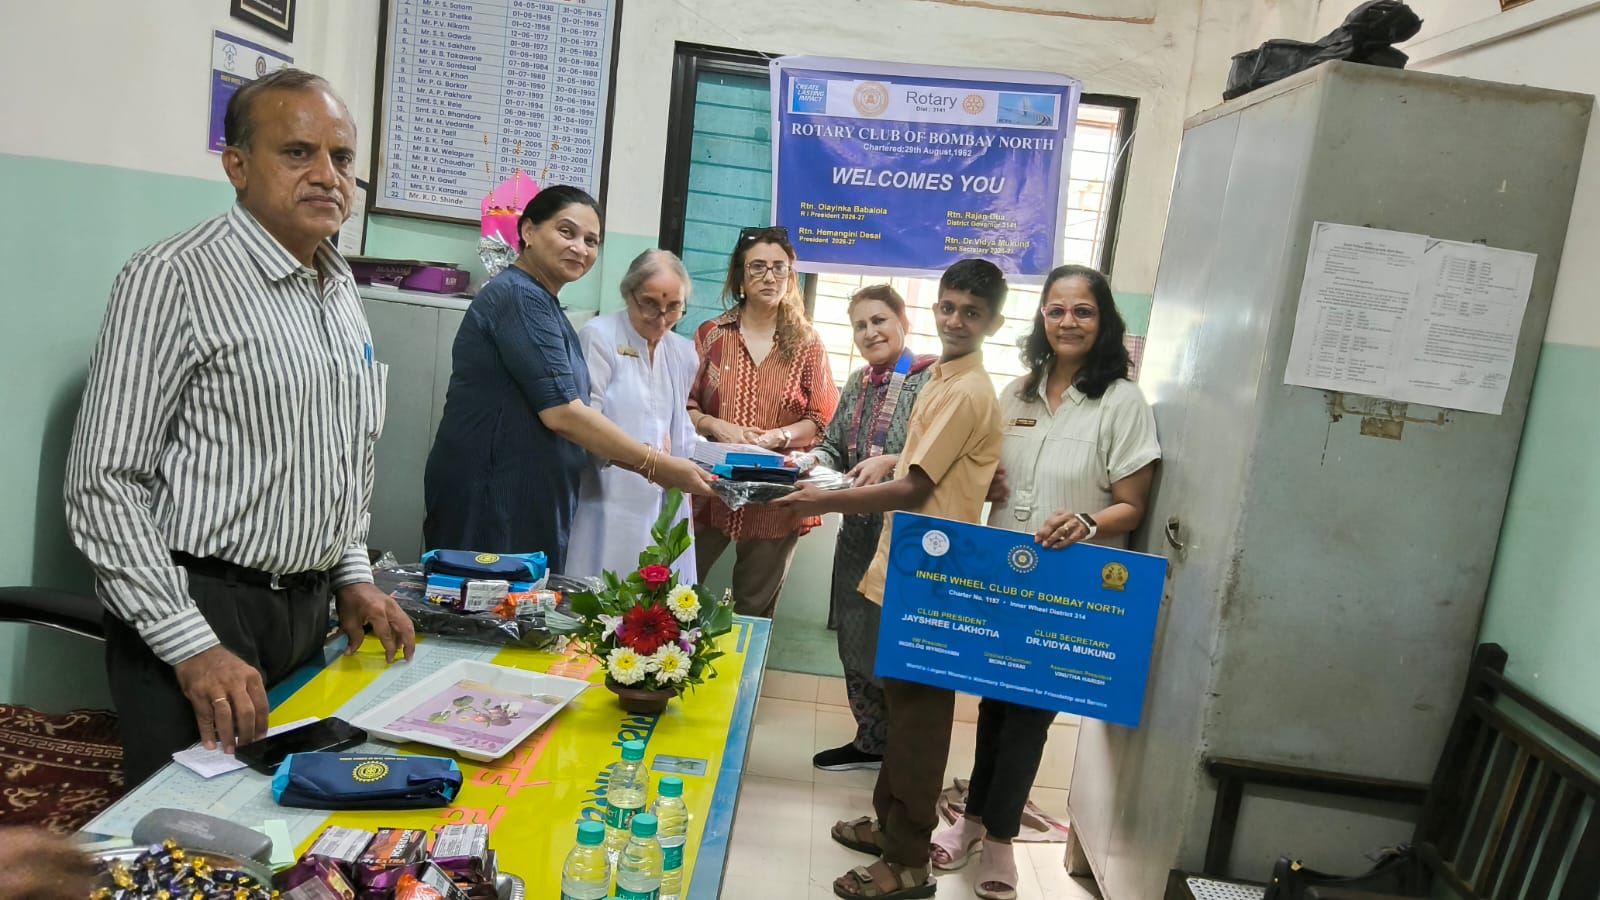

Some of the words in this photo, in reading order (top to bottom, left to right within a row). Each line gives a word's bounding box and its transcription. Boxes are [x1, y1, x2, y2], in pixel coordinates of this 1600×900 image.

[451, 72, 468, 80] Khan
[906, 91, 958, 109] Rotary
[442, 129, 457, 137] Patil
[791, 123, 855, 139] ROTARY
[858, 127, 900, 142] CLUB
[904, 130, 926, 143] OF
[929, 134, 996, 148] BOMBAY
[1000, 136, 1054, 150] NORTH
[832, 167, 954, 192] WELCOMES
[961, 176, 1005, 194] YOU
[440, 196, 464, 205] Shinde
[801, 202, 816, 210] Rtn.
[854, 205, 888, 215] Babalola
[947, 211, 962, 219] Rtn.
[799, 227, 814, 235] Rtn.
[817, 228, 858, 238] Hemangini
[860, 232, 881, 240] Desai
[800, 236, 828, 244] President
[945, 236, 961, 244] Rtn.
[998, 240, 1030, 248] Mukund
[959, 246, 988, 254] Secretary
[916, 570, 948, 583] INNER
[950, 576, 986, 590] WHEEL
[989, 583, 1018, 596] CLUB
[1021, 589, 1036, 598] OF
[1038, 593, 1084, 608] BOMBAY
[1087, 602, 1125, 616] NORTH
[948, 589, 972, 598] Charter
[973, 593, 983, 601] No.
[1010, 601, 1026, 609] Inner
[1028, 604, 1048, 613] Wheel
[1050, 608, 1073, 618] District
[917, 608, 939, 617] CLUB
[941, 612, 987, 626] PRESIDENT
[902, 614, 950, 629] JAYSHREE
[952, 623, 1000, 639] LAKHOTIA
[1034, 629, 1057, 639] CLUB
[1059, 633, 1110, 649] SECRETARY
[1073, 645, 1116, 660] MUKUND
